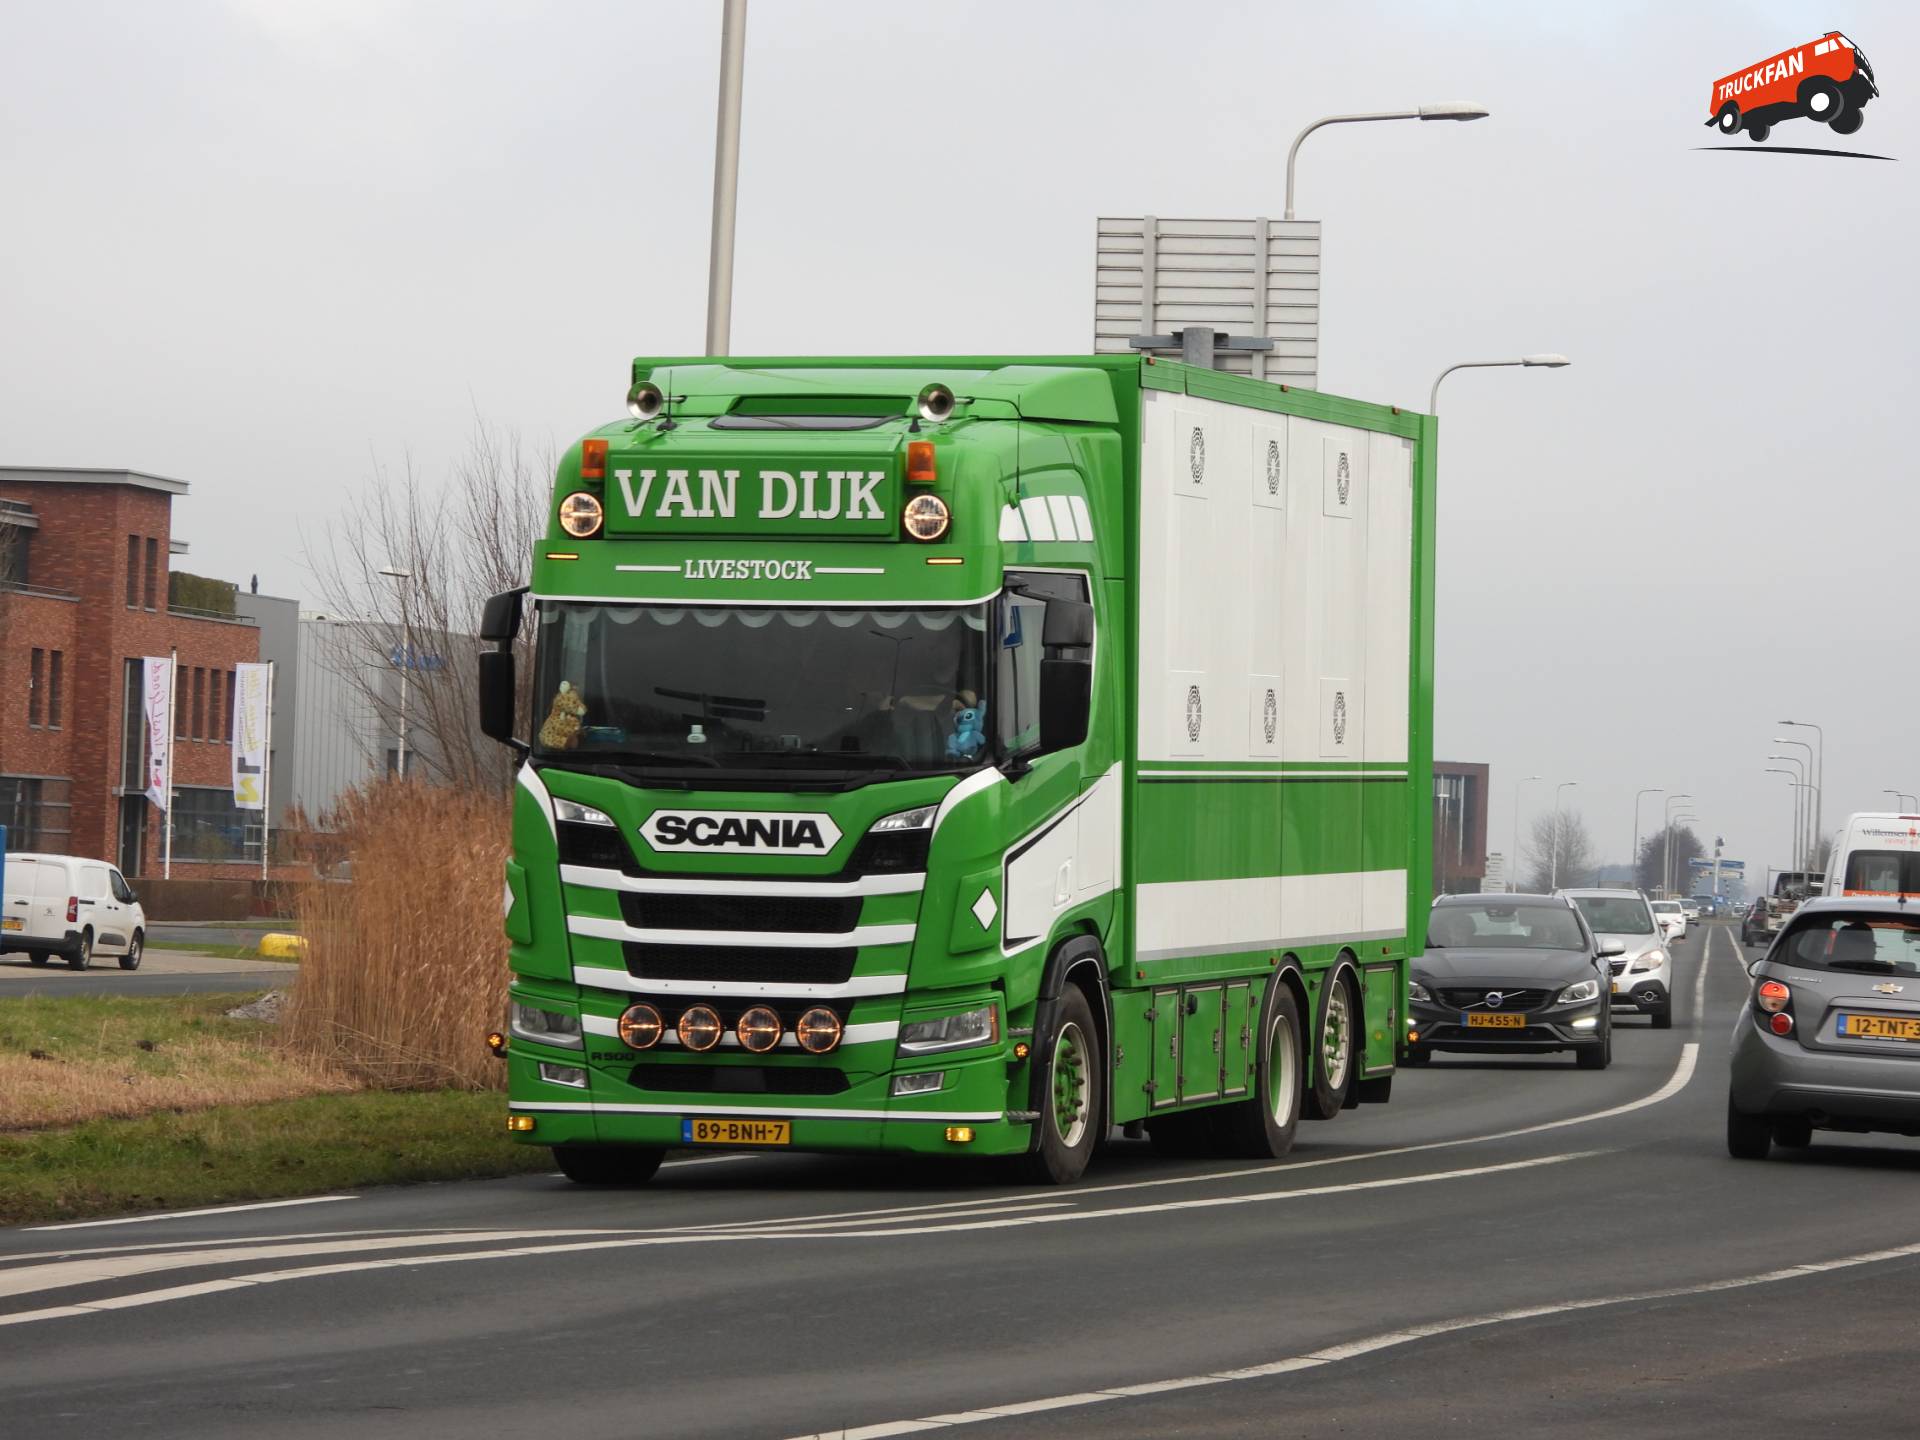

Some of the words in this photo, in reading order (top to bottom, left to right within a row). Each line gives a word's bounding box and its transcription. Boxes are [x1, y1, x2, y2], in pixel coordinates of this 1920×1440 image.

[614, 469, 740, 518] VAN
[758, 471, 885, 520] DIJK
[684, 559, 812, 580] LIVESTOCK
[654, 815, 825, 849] SCANIA
[1470, 1015, 1521, 1026] HJ-455-N
[1855, 1018, 1920, 1036] 12-TNT-3
[591, 1051, 635, 1062] R500
[696, 1122, 784, 1141] 89-BNH-7
